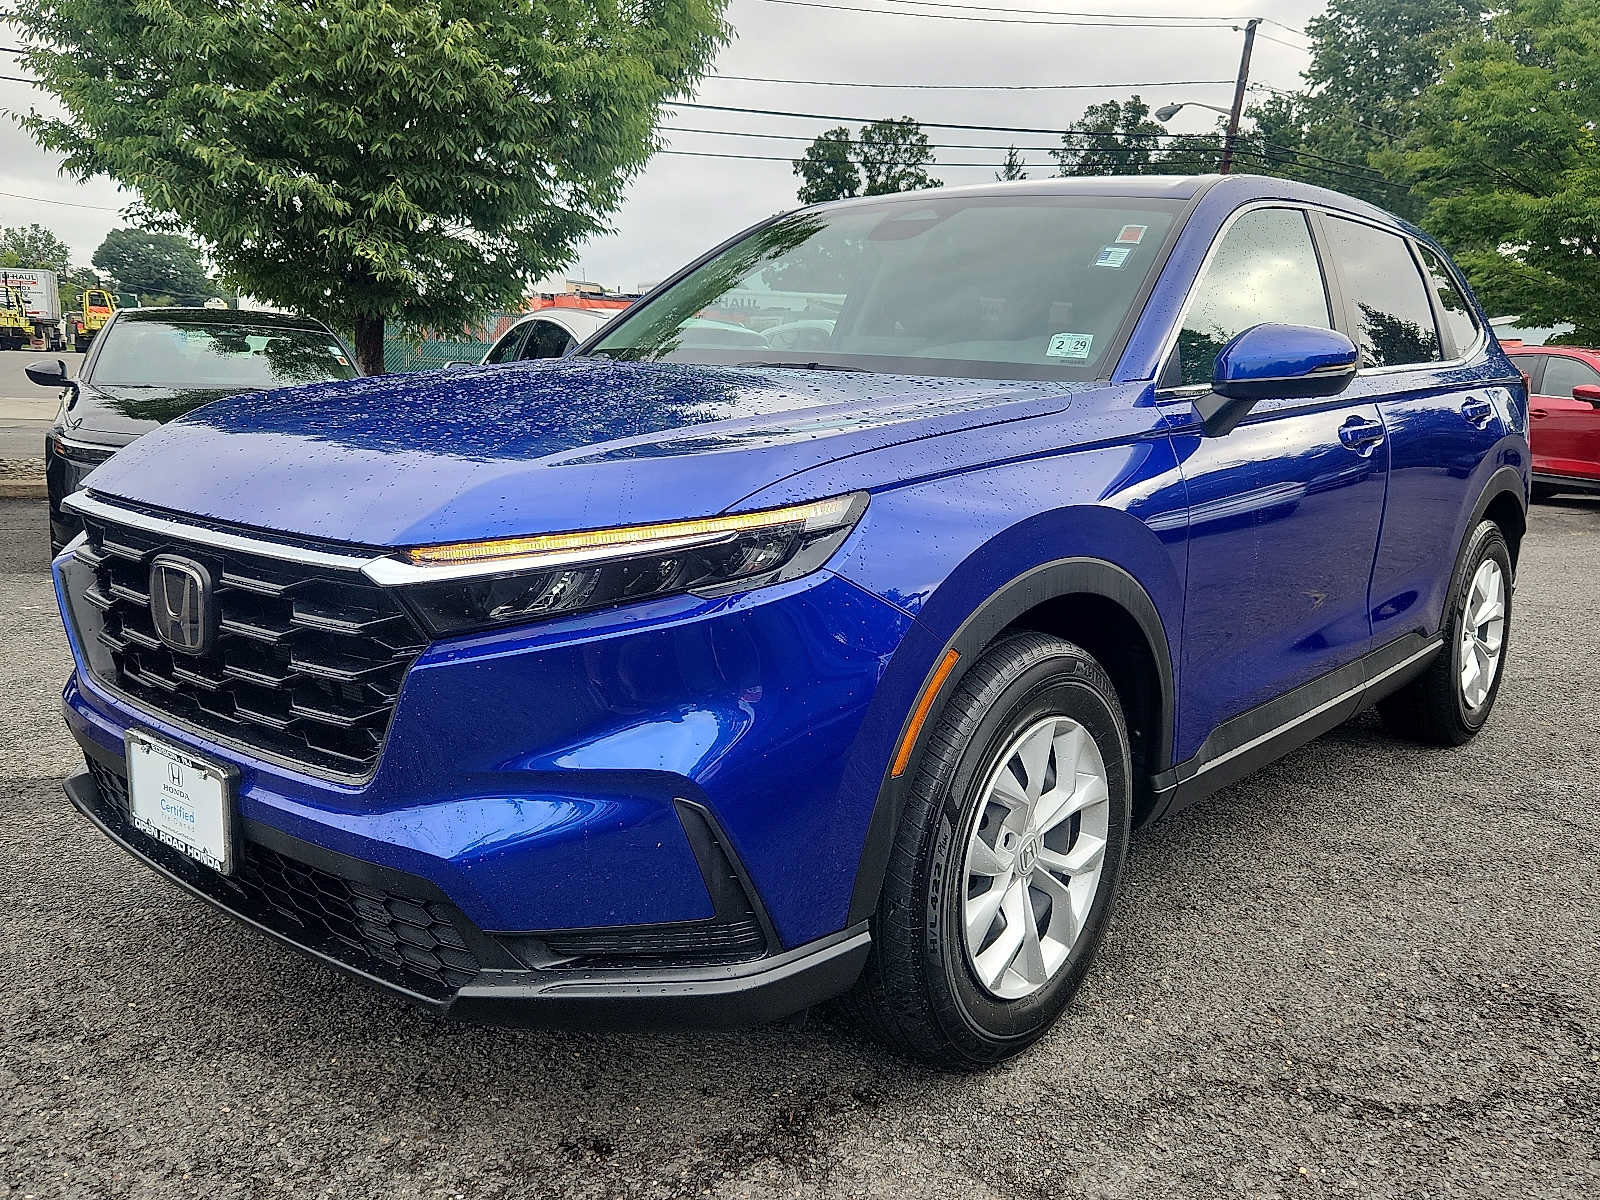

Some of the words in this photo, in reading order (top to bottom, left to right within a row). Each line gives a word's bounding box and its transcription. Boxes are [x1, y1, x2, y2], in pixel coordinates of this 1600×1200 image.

[1055, 340, 1065, 350] 2
[1072, 340, 1087, 351] 29
[163, 783, 190, 801] HONDA
[160, 798, 195, 824] Certified
[134, 818, 158, 838] OPEN
[159, 832, 186, 852] ROAD
[187, 843, 222, 872] HONDA
[937, 833, 949, 857] Plus
[930, 861, 943, 911] 422
[929, 915, 938, 954] H/L
